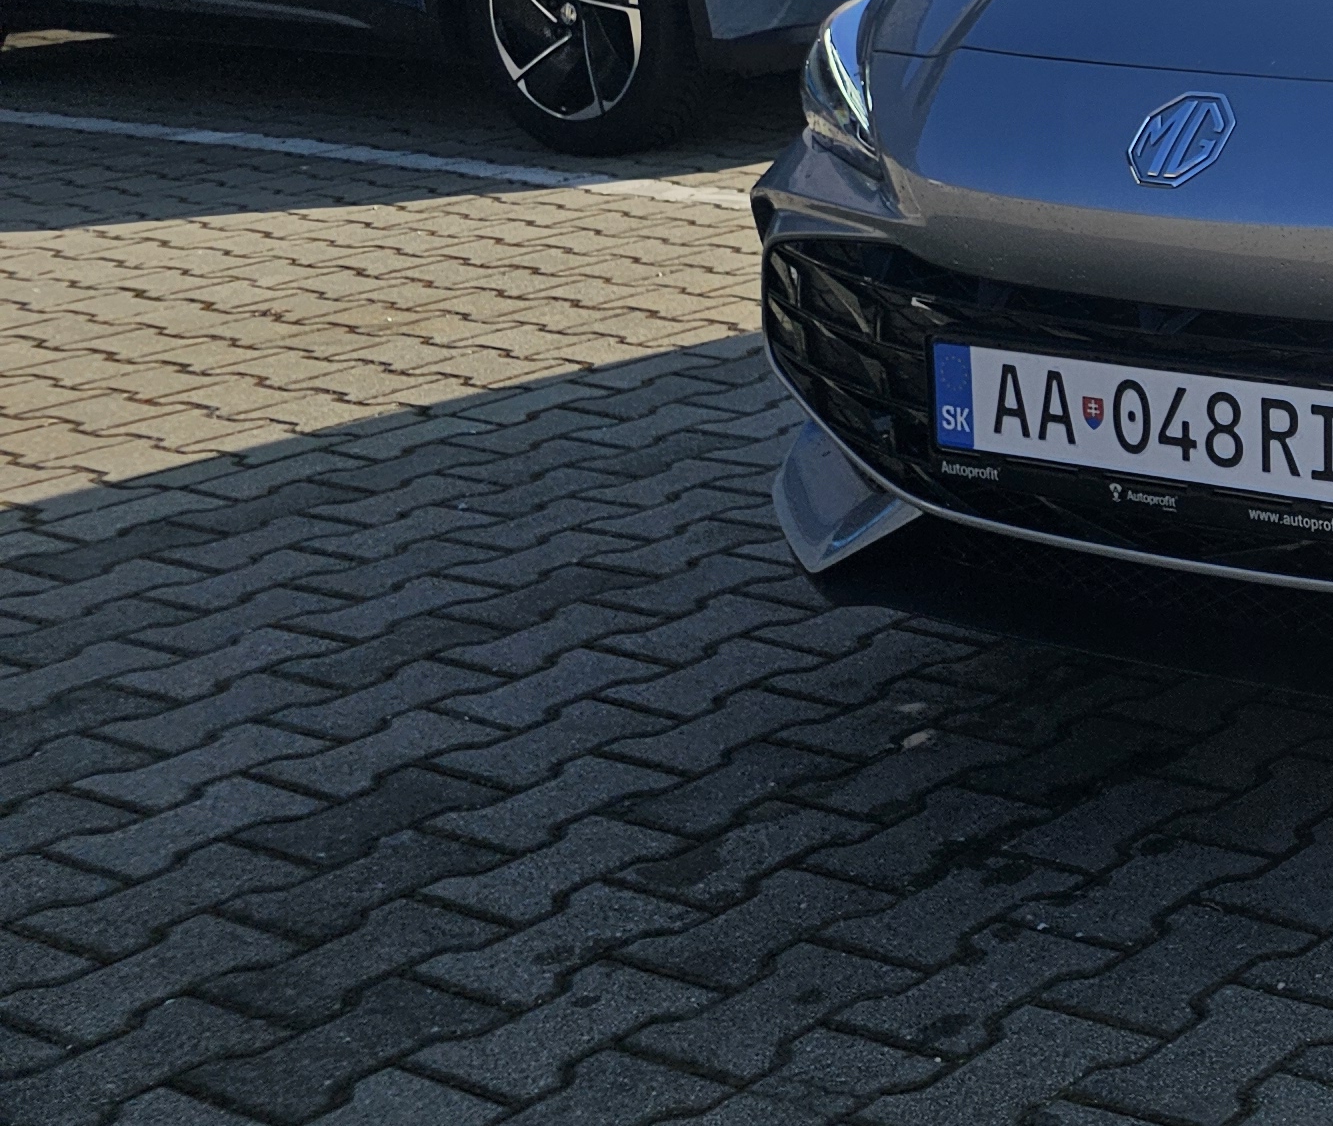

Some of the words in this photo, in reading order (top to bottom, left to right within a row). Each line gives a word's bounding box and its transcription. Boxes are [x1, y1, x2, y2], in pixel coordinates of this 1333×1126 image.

[1135, 100, 1225, 178] MG
[993, 363, 1076, 446] AA
[942, 405, 971, 433] SK
[941, 461, 1000, 482] Autoprofit
[1126, 490, 1177, 508] Autoprofit
